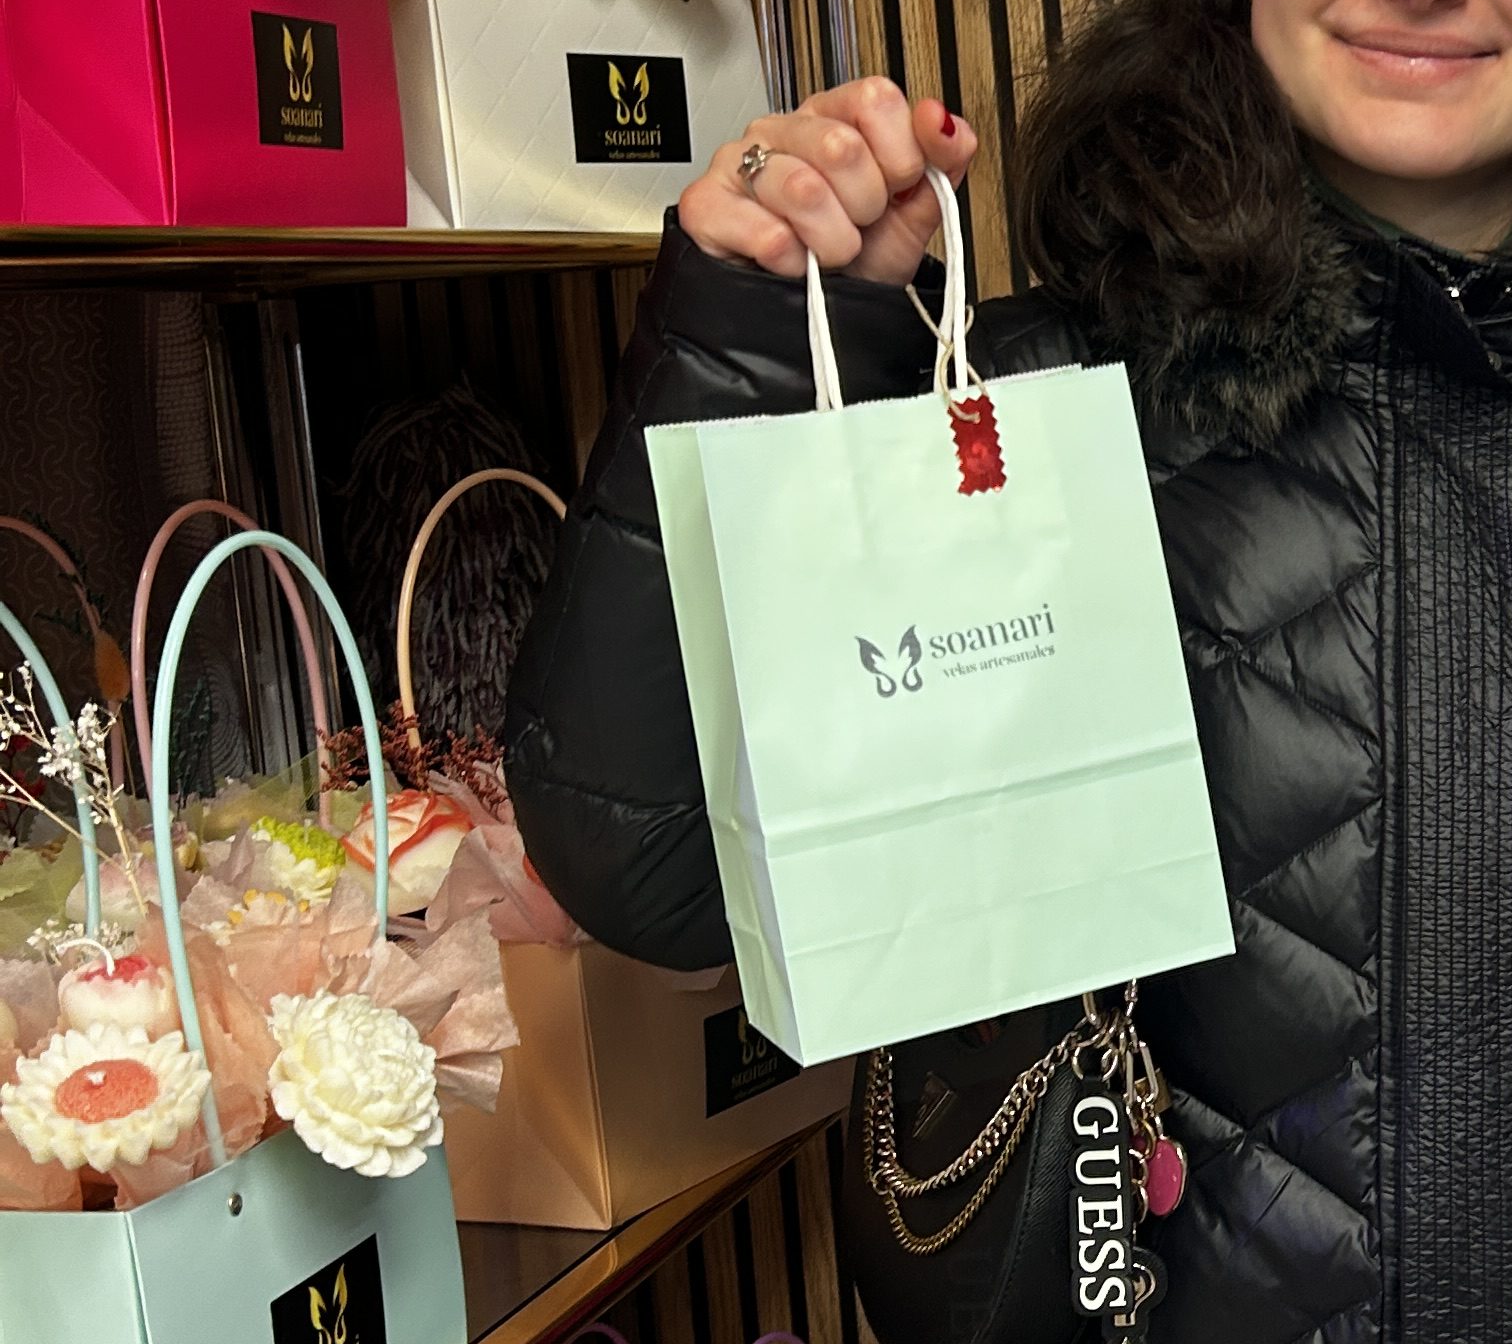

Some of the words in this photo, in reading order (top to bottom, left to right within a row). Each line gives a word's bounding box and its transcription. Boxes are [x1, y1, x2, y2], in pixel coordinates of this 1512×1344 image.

[604, 123, 662, 146] soanari
[928, 602, 1056, 660] soanari
[942, 660, 978, 679] velas
[979, 642, 1057, 675] artesanales
[1072, 1095, 1128, 1312] GUESS
